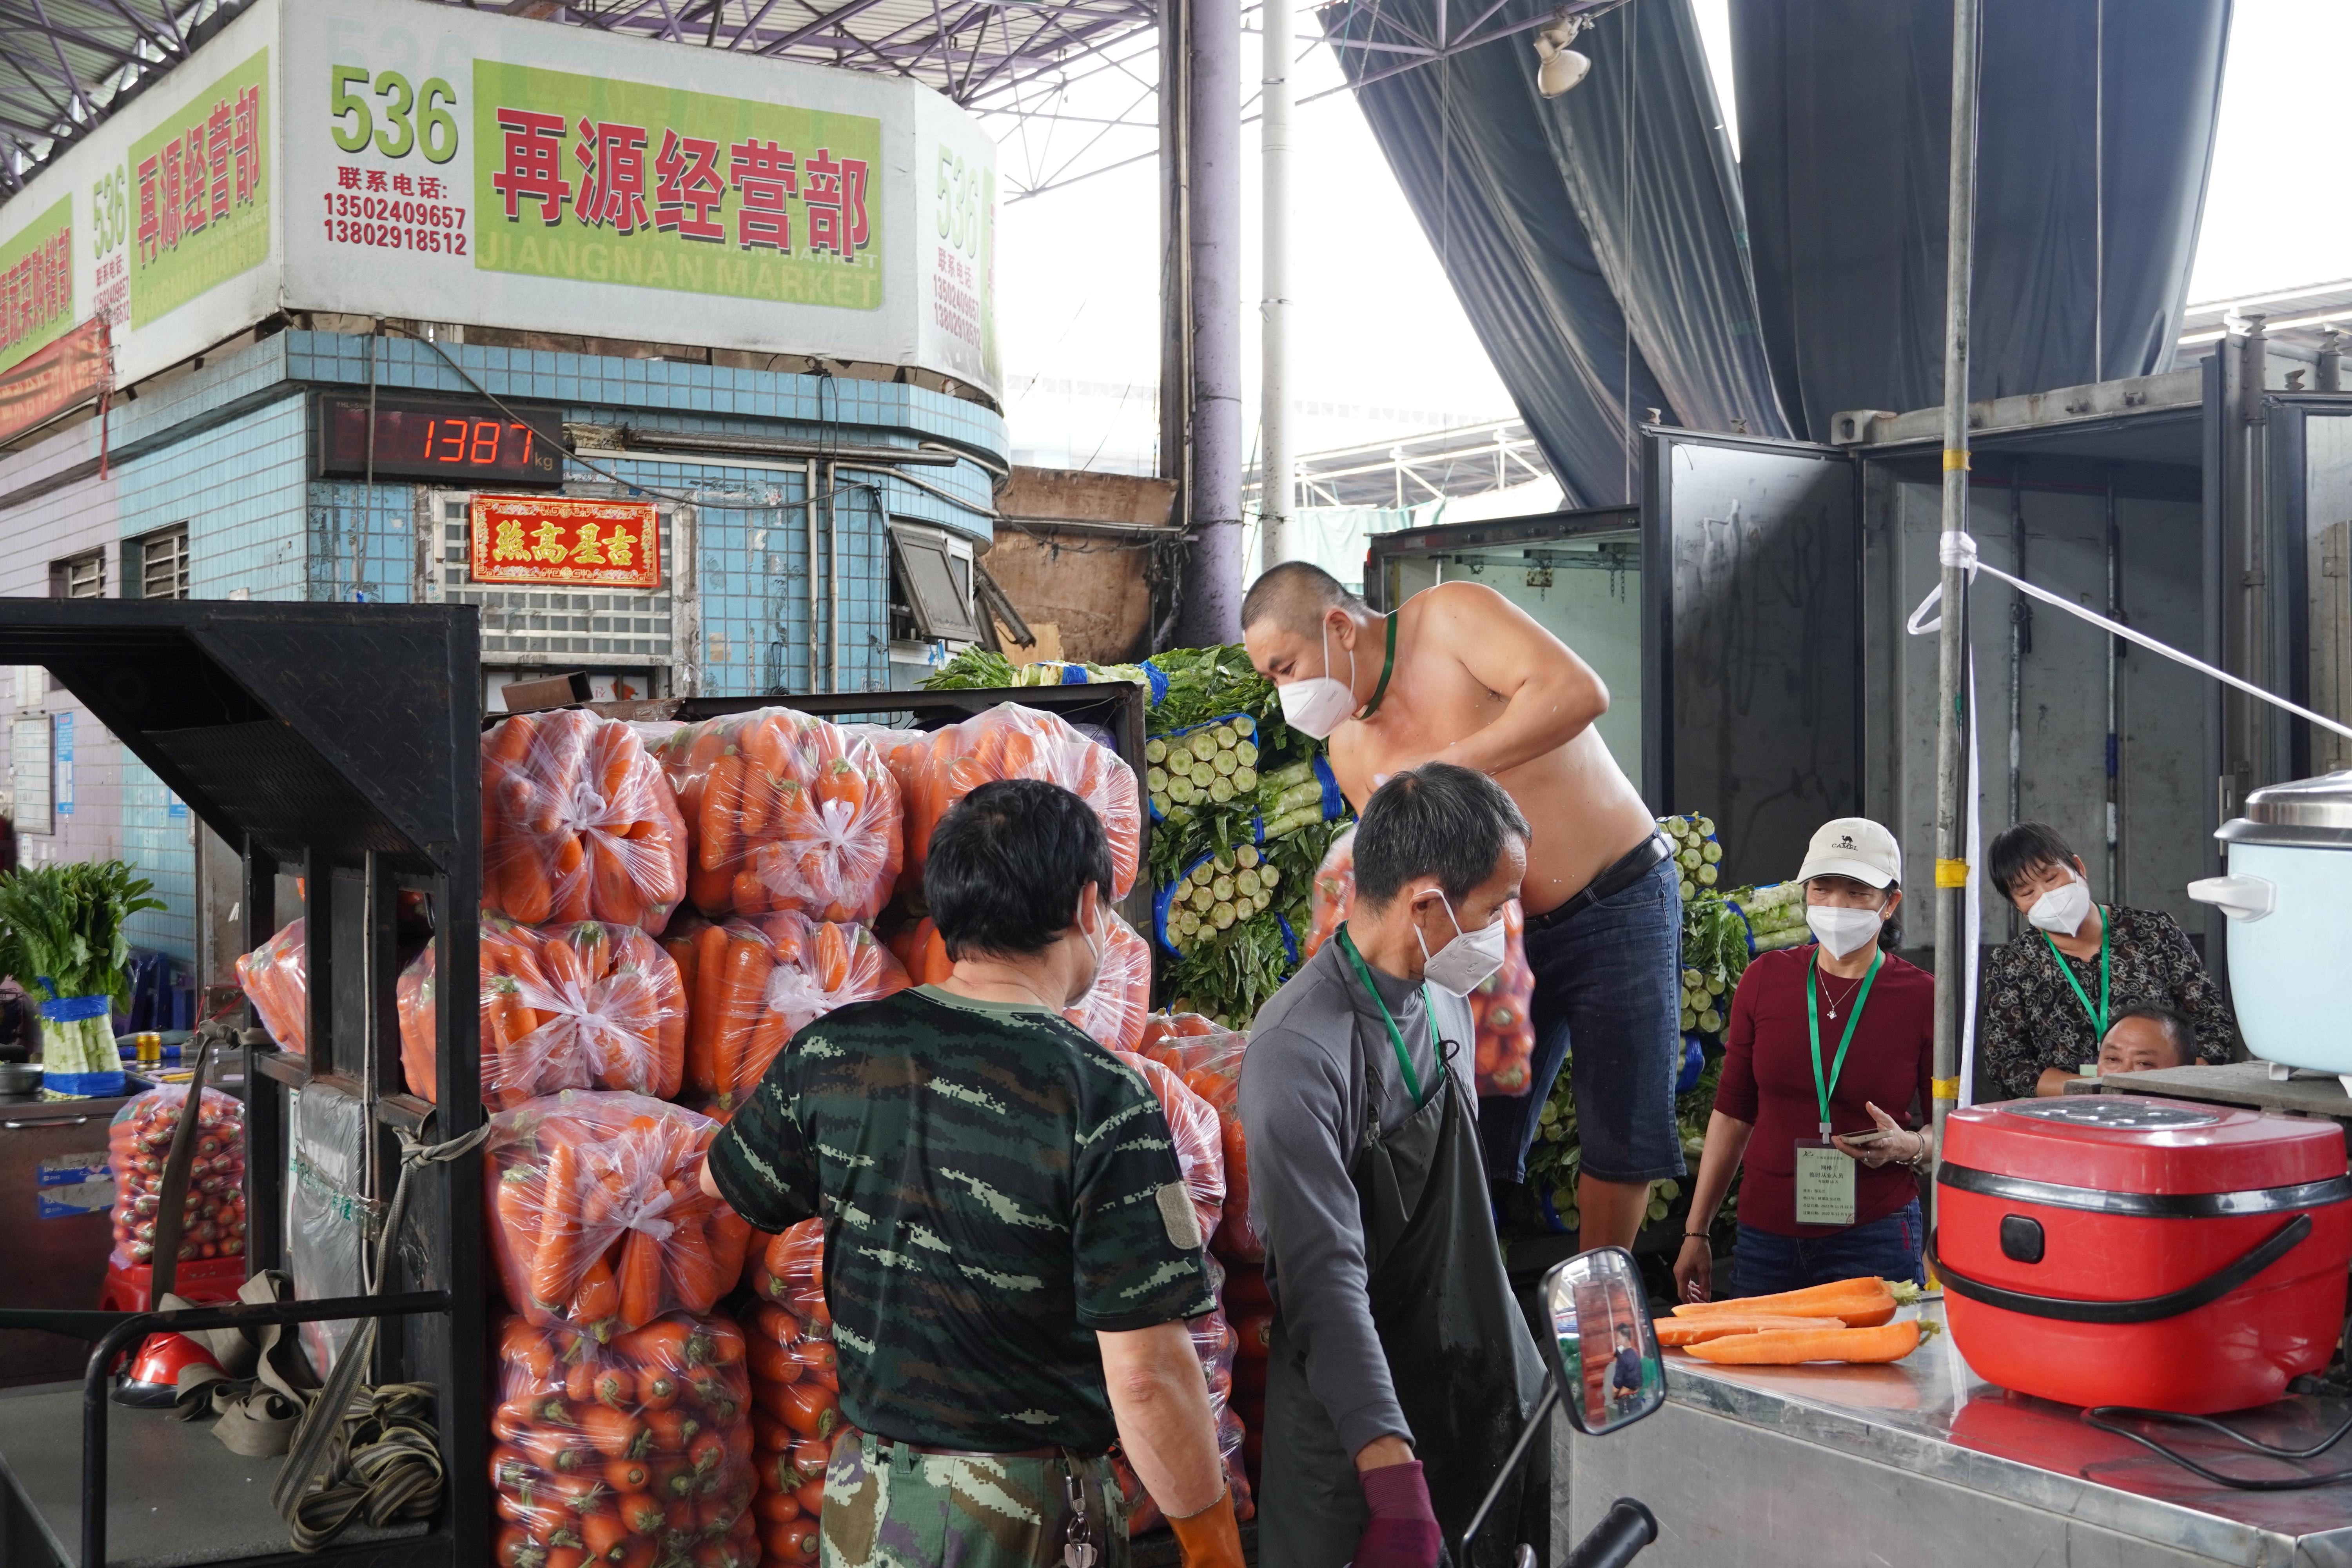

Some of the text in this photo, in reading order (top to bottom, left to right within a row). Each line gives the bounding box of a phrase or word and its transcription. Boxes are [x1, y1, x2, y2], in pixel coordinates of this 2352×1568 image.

[331, 64, 458, 164] 536
[93, 164, 126, 260] 536
[138, 83, 260, 269] 再源经营部
[324, 192, 466, 230] 13502409657
[493, 107, 870, 262] 再源经营部
[936, 143, 978, 259] 536
[324, 219, 467, 256] 13802918512
[477, 231, 877, 307] JIANGNAN MARKET
[934, 274, 979, 323] 13502409657
[934, 301, 981, 351] 13802918512
[424, 419, 553, 470] 1387 kg
